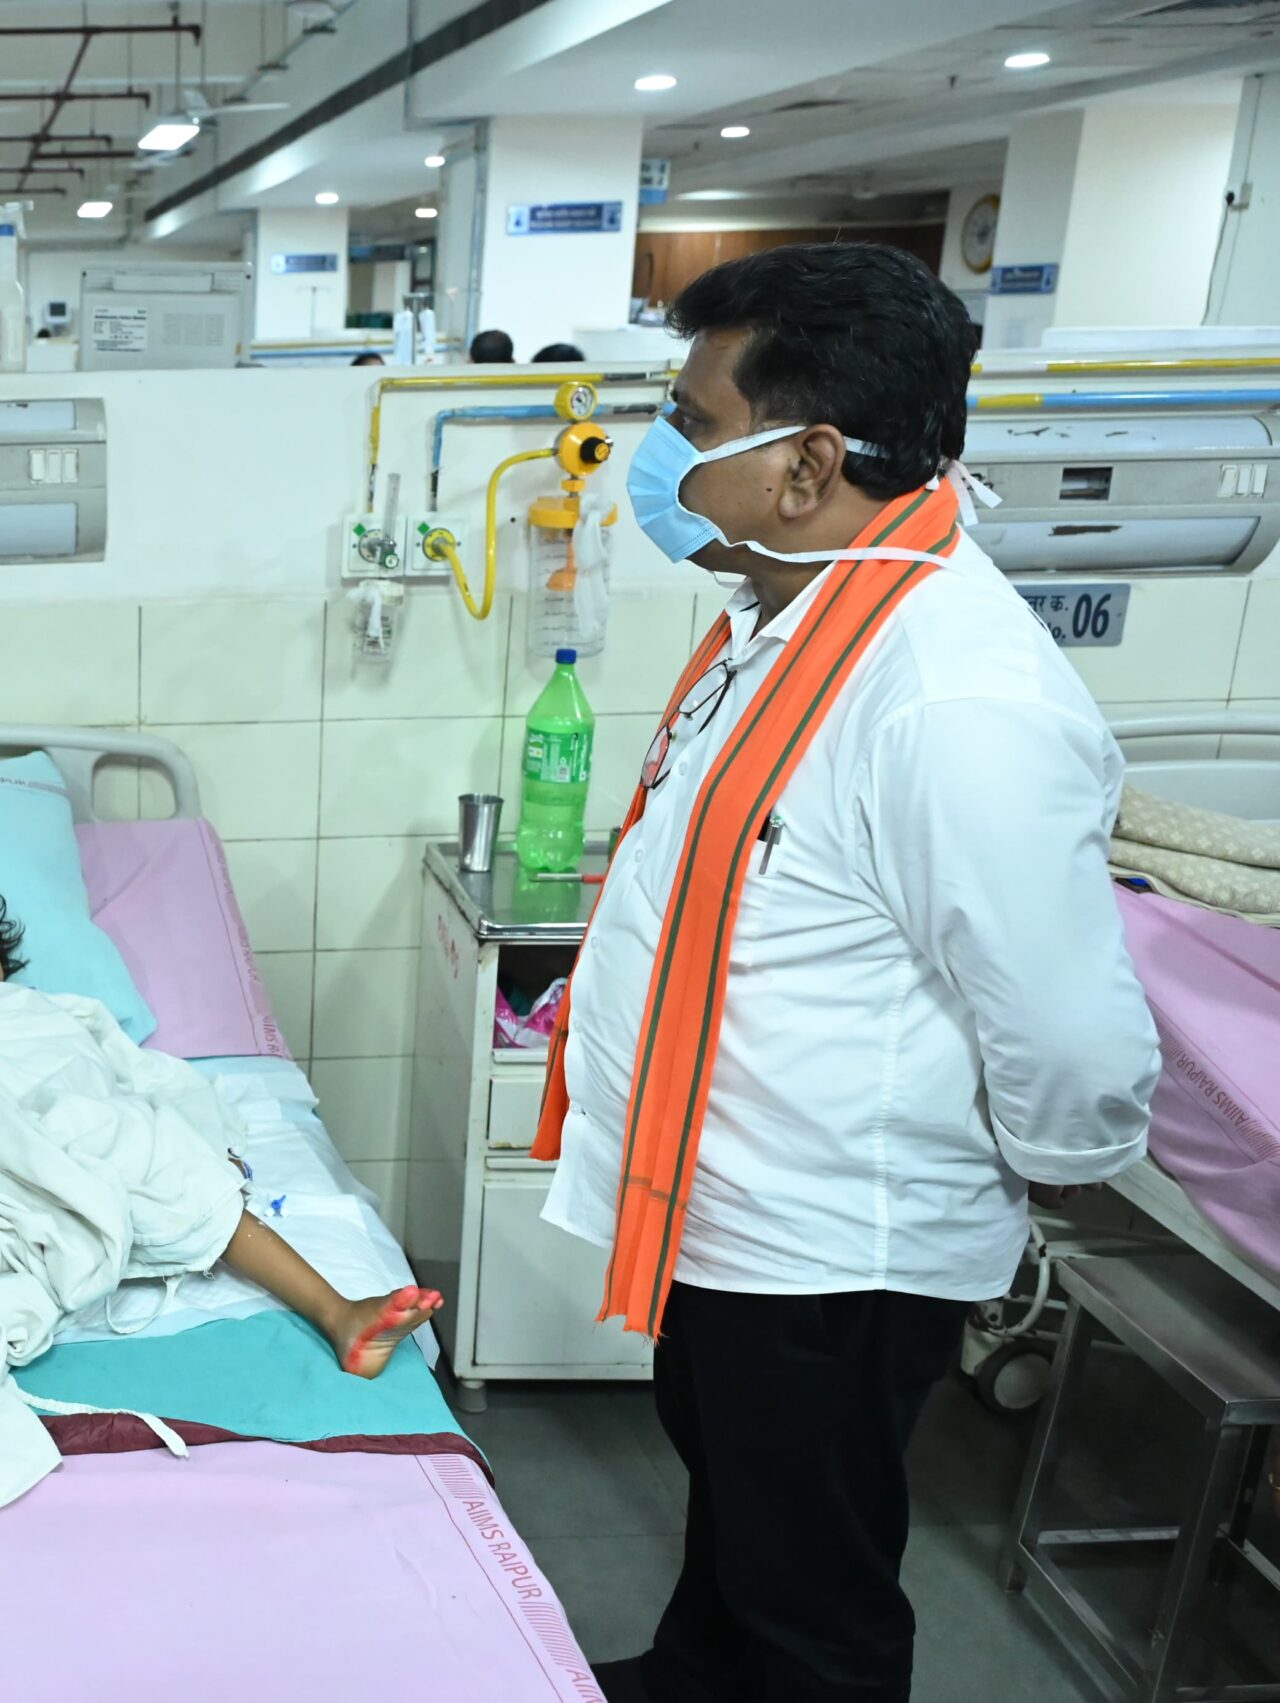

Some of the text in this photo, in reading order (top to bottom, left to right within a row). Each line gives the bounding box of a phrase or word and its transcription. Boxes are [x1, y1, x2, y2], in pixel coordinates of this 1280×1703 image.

[1072, 592, 1112, 638] 06
[1176, 1052, 1250, 1126] AIIMS RAIPUR
[462, 1500, 543, 1600] AIIMS RAIPUR
